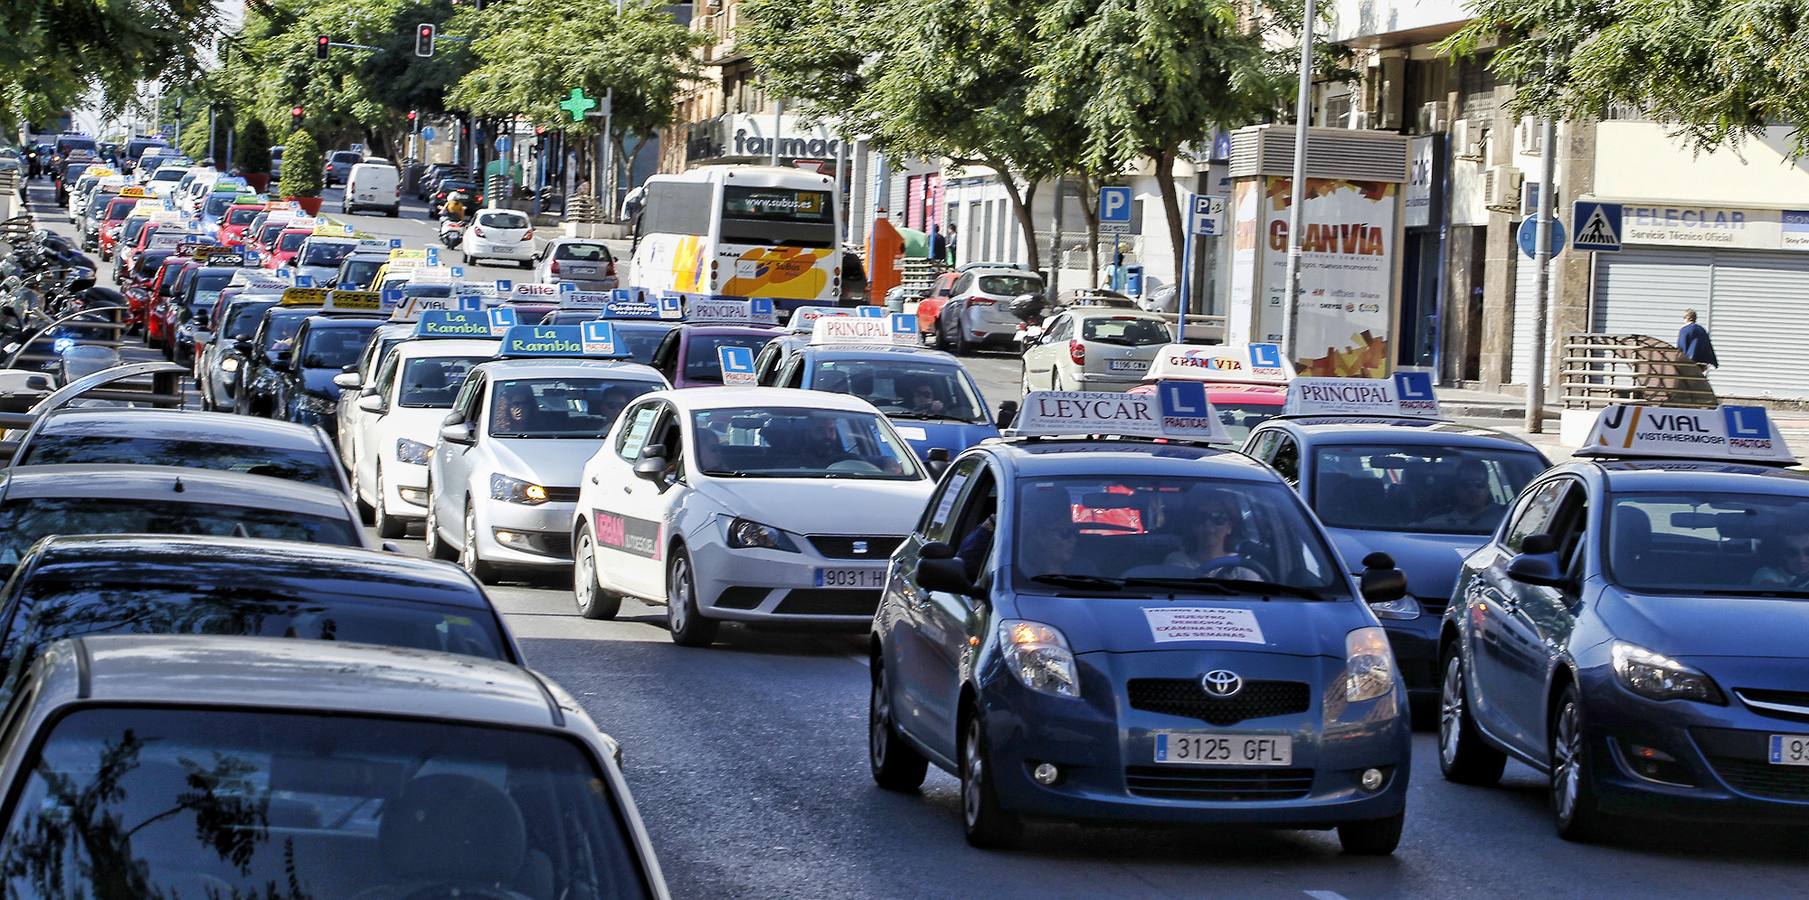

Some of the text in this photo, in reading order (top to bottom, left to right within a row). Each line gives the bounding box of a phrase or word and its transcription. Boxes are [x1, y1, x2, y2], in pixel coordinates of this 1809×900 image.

[1106, 191, 1124, 218] P
[1623, 207, 1745, 230] TELECLAR
[1630, 229, 1665, 240] Servicio
[1705, 231, 1733, 243] Oficial
[420, 301, 450, 310] VIAL
[570, 295, 610, 303] FLEMING
[446, 312, 466, 322] La
[696, 305, 748, 318] PRINCIPAL
[426, 322, 488, 335] Rambla
[534, 327, 556, 339] La
[589, 325, 606, 341] L
[826, 321, 889, 337] PRINCIPAL
[512, 339, 582, 352] Rambla
[728, 351, 747, 370] L
[1170, 356, 1209, 368] GRAN
[1255, 347, 1274, 365] L
[1300, 385, 1393, 403] PRINCIPAL
[1402, 376, 1424, 397] L
[1038, 391, 1149, 401] AUTO ESCUELA
[1170, 387, 1196, 413] L
[1039, 399, 1153, 421] LEYCAR
[1164, 417, 1208, 429] PRACTICAS
[1648, 414, 1710, 433] VIAL
[1734, 411, 1759, 434] L
[1637, 432, 1726, 445] VISTAHERMOSA
[1729, 438, 1772, 449] PRACTICAS
[826, 570, 865, 586] 9031
[1177, 738, 1283, 761] 3125 GFL
